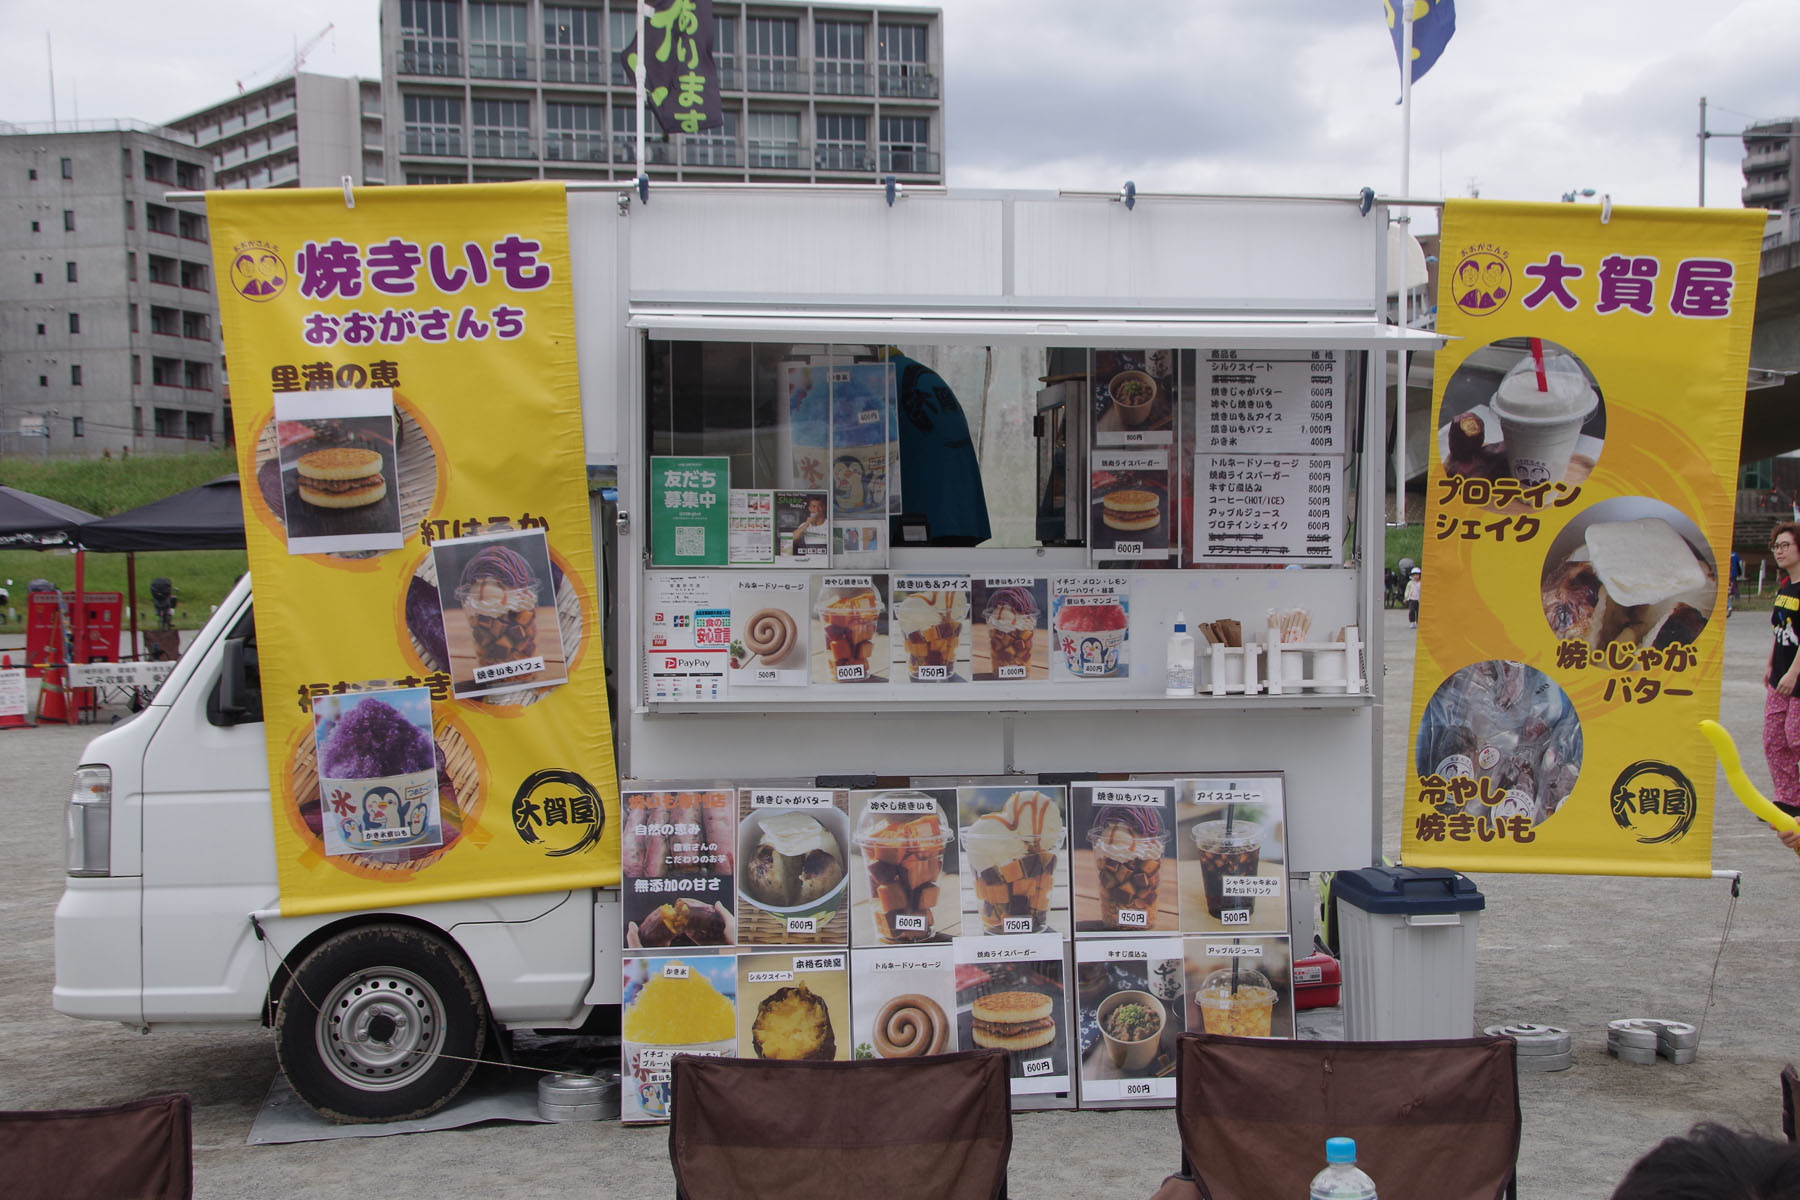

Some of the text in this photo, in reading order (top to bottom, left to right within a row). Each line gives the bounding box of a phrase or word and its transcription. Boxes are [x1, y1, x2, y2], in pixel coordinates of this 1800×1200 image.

[297, 235, 551, 299] 焼きいも
[1523, 253, 1735, 318] 大賀屋
[305, 306, 524, 344] おおがさんち
[1211, 363, 1273, 372] シルクスイート
[1210, 387, 1333, 397] 焼きじゃがバター 600円
[1210, 400, 1333, 409] 冷やし焼きいも 600円
[1310, 413, 1333, 422] 750円
[1210, 437, 1333, 447] かき氷 400円
[1211, 458, 1331, 469] トルネードソーセージ 500円
[664, 470, 716, 488] 友だち
[1209, 470, 1331, 481] 焼肉ライスバーガー 600円
[1308, 485, 1330, 494] 800円
[1437, 476, 1581, 508] プロテイン
[664, 491, 716, 509] 募集中
[1209, 496, 1330, 506] コーヒー(HOT/ICE) 500円
[1209, 508, 1330, 518] アップルジュース 400円
[1208, 521, 1330, 531] プロテインシェイク 600円
[1436, 515, 1541, 542] シェイク
[1117, 544, 1141, 553] 600円
[738, 582, 804, 590] トルネードソーセージ
[824, 578, 870, 586] 冷やし焼きいも
[897, 580, 969, 589] 焼きいも&アイス
[987, 578, 1033, 586] 焼きいもパフェ
[1556, 641, 1698, 672] 焼・じゃが
[678, 659, 710, 668] PayPay
[477, 662, 542, 680] 焼きいもパフェ
[838, 667, 863, 677] 600円
[920, 667, 945, 677] 750円
[1603, 679, 1693, 703] バター
[1418, 776, 1506, 805] 冷やし
[756, 796, 830, 805] 焼きじゃがバター
[1097, 792, 1159, 803] 焼きいもパフェ
[1197, 792, 1261, 801] アイスコーヒー
[1613, 787, 1687, 815] 大賀屋
[331, 789, 357, 817] 氷
[870, 801, 934, 811] 冷やし焼きいも
[516, 795, 596, 828] 大賀屋
[635, 824, 701, 836] 自然の恵み
[1415, 813, 1536, 843] 焼きいも
[665, 855, 727, 864] こだわりのお芋
[634, 878, 721, 892] 無添加の甘さ
[1121, 912, 1145, 923] 950円
[1224, 912, 1248, 922] 500円
[790, 920, 813, 930] 600円
[899, 918, 921, 928] 600円
[1006, 920, 1030, 930] 750円
[977, 949, 1036, 958] 焼肉ライスバーガー
[1208, 946, 1260, 955] アップルジュース
[666, 968, 686, 976] かき氷
[750, 973, 793, 981] シルクスイート
[1027, 1061, 1050, 1072] 600円
[1128, 1084, 1150, 1094] 800円
